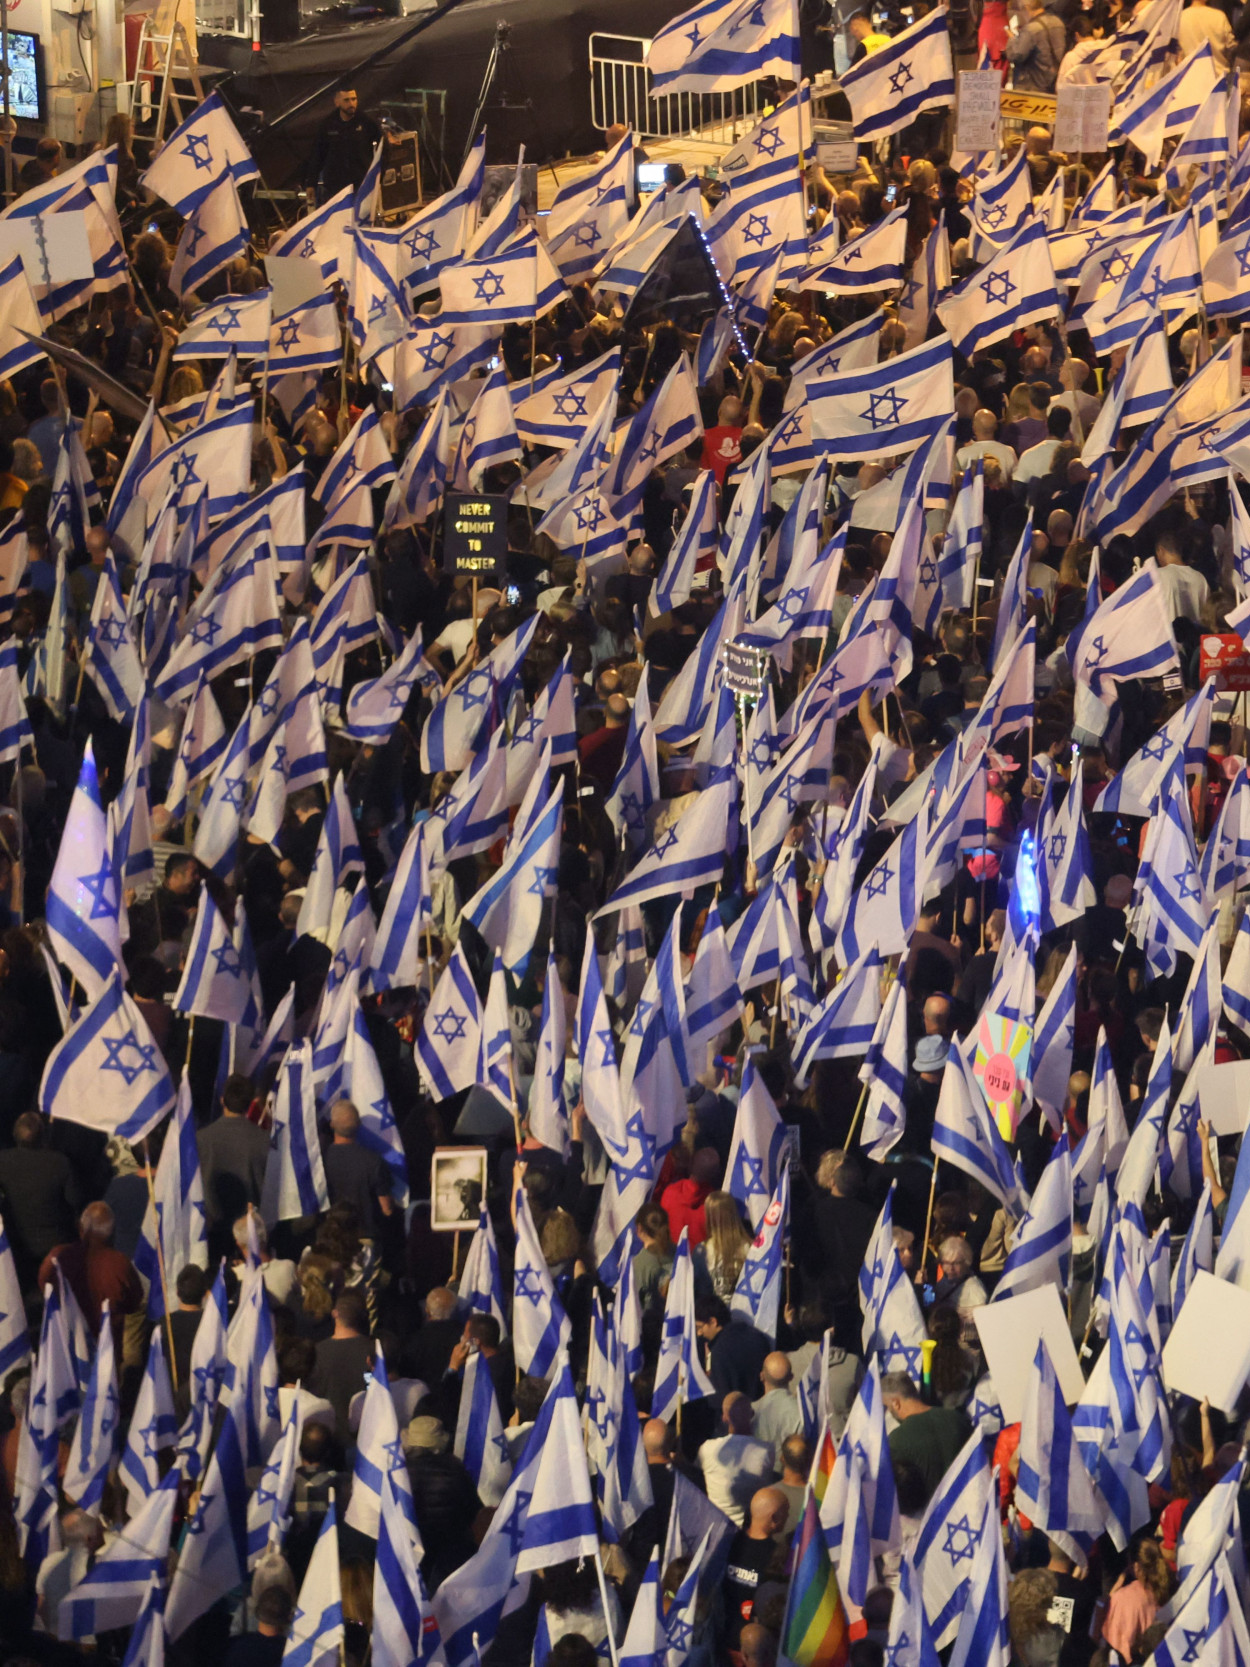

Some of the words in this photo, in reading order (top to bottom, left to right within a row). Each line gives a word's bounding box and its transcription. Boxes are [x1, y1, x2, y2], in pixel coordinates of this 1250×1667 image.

[459, 503, 491, 516] NEVER
[455, 521, 495, 534] COMMIT
[468, 539, 482, 551] TO
[456, 557, 496, 570] MASTER
